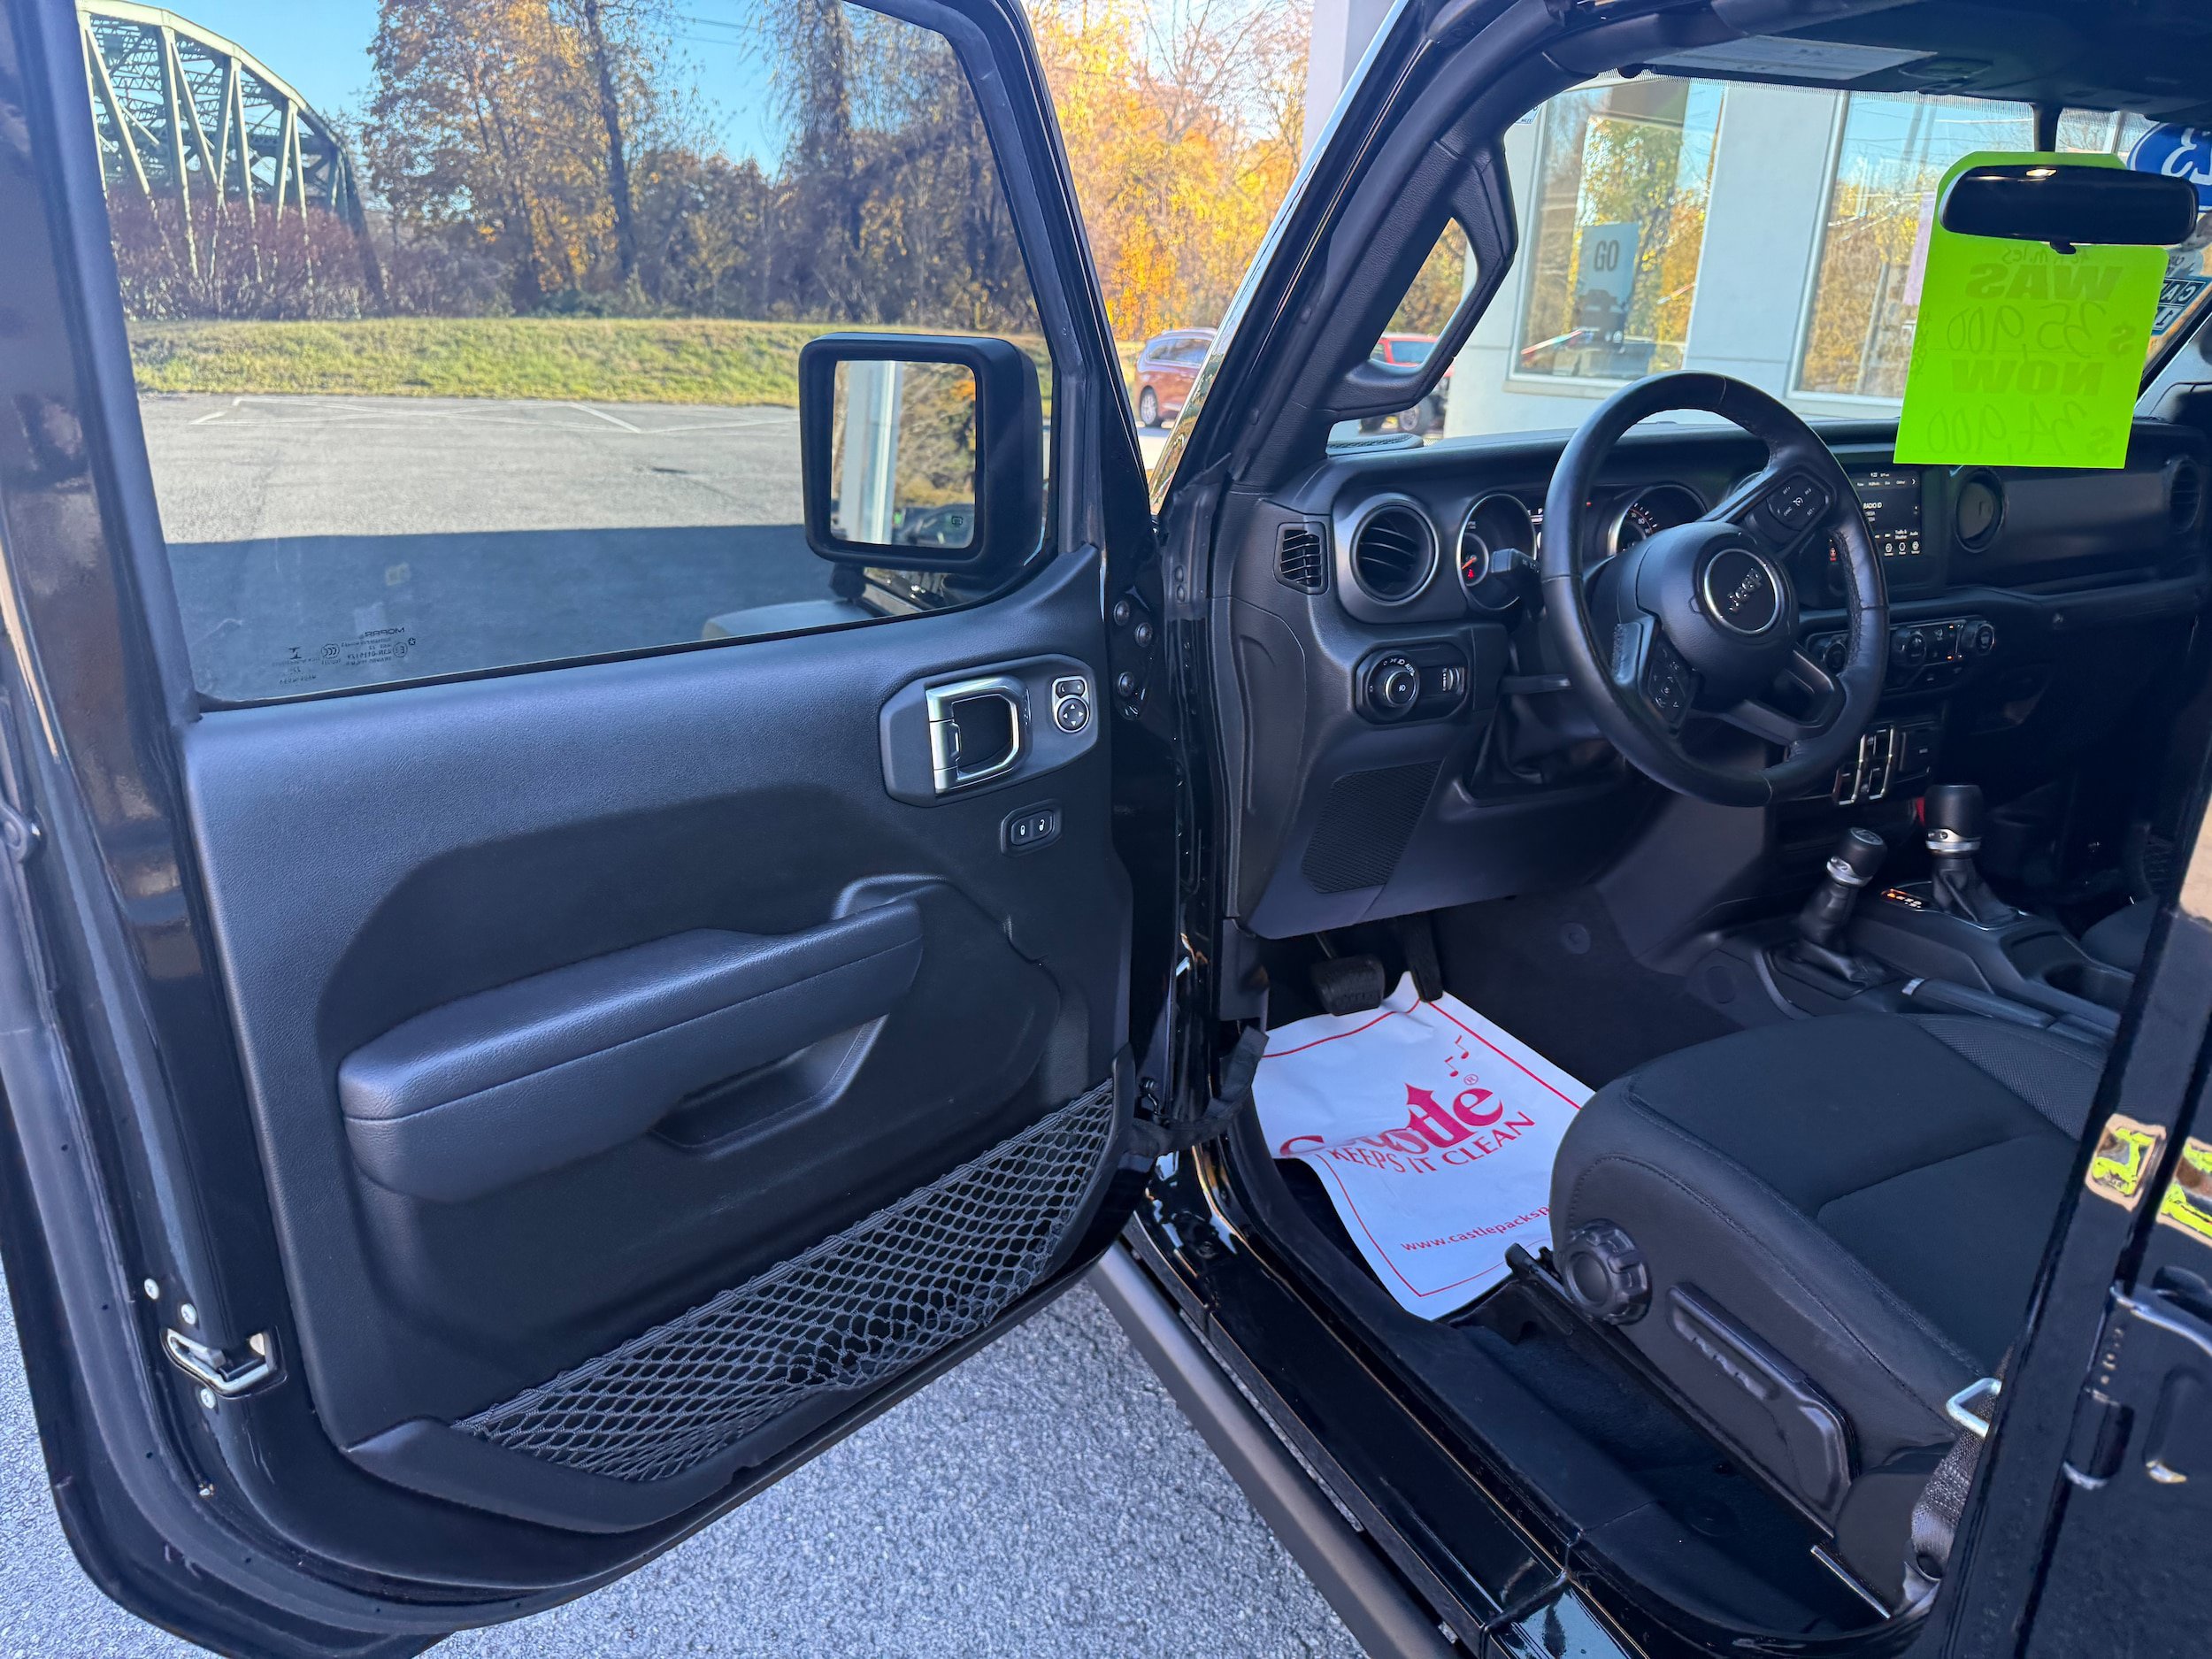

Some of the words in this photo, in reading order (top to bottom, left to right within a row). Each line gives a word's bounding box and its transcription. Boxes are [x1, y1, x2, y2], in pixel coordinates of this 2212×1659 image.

[1594, 240, 1620, 272] GO
[1326, 1147, 1406, 1173] KEEPS
[1406, 1156, 1438, 1173] IT
[1441, 1110, 1536, 1165] CLEAN
